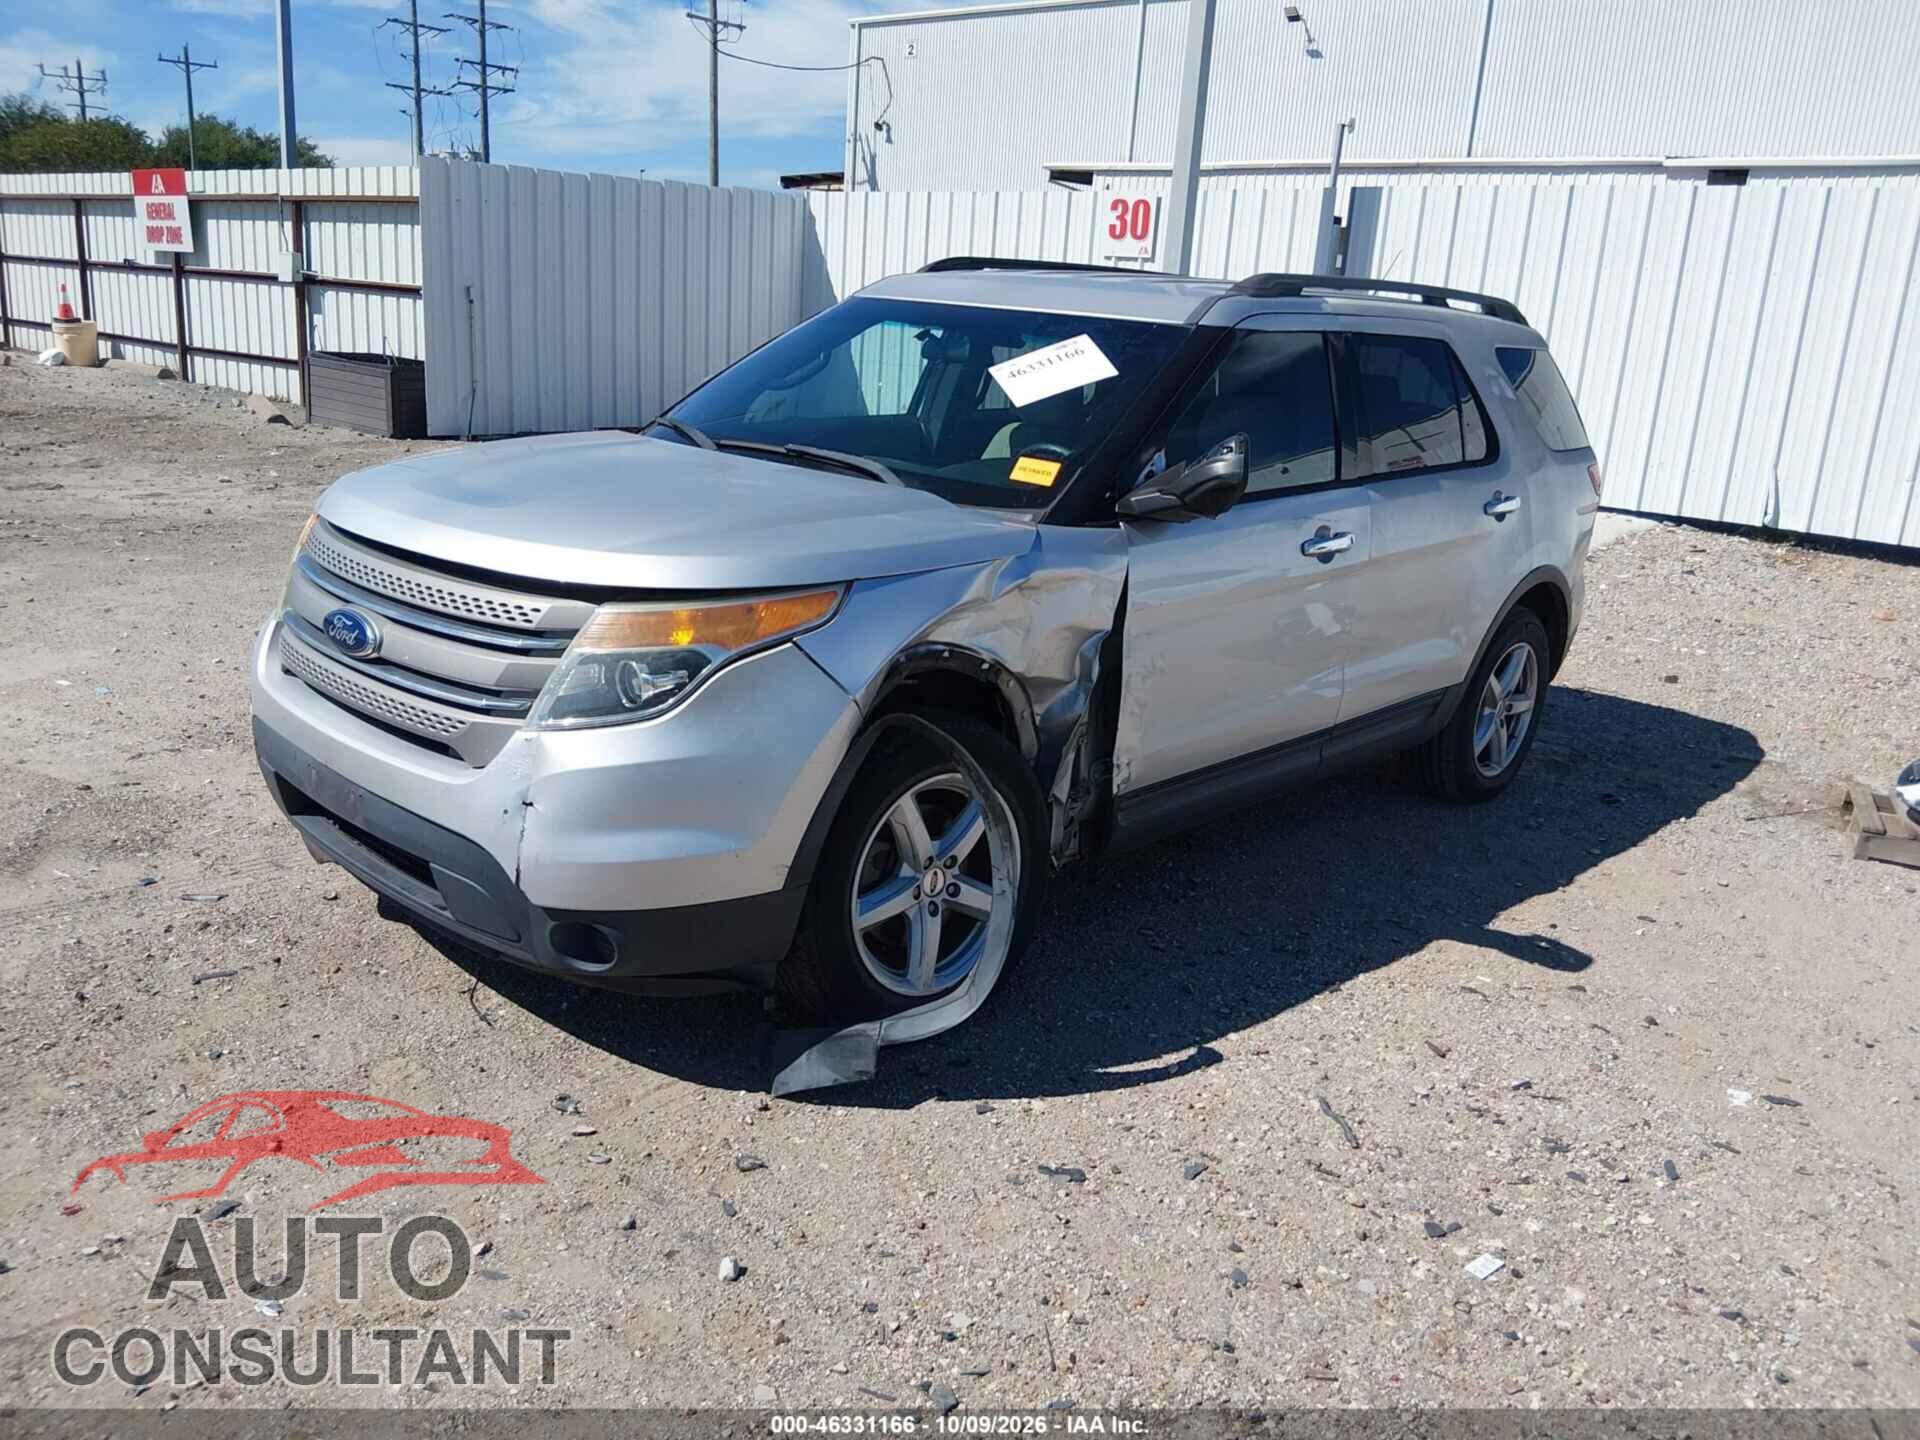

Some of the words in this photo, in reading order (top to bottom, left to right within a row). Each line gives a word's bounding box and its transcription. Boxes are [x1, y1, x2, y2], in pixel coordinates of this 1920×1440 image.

[907, 44, 915, 56] 2
[145, 202, 176, 221] GENERAL
[1108, 198, 1151, 241] 30
[166, 226, 183, 245] ZONE
[1007, 347, 1086, 379] 46331166
[328, 614, 360, 646] Ford
